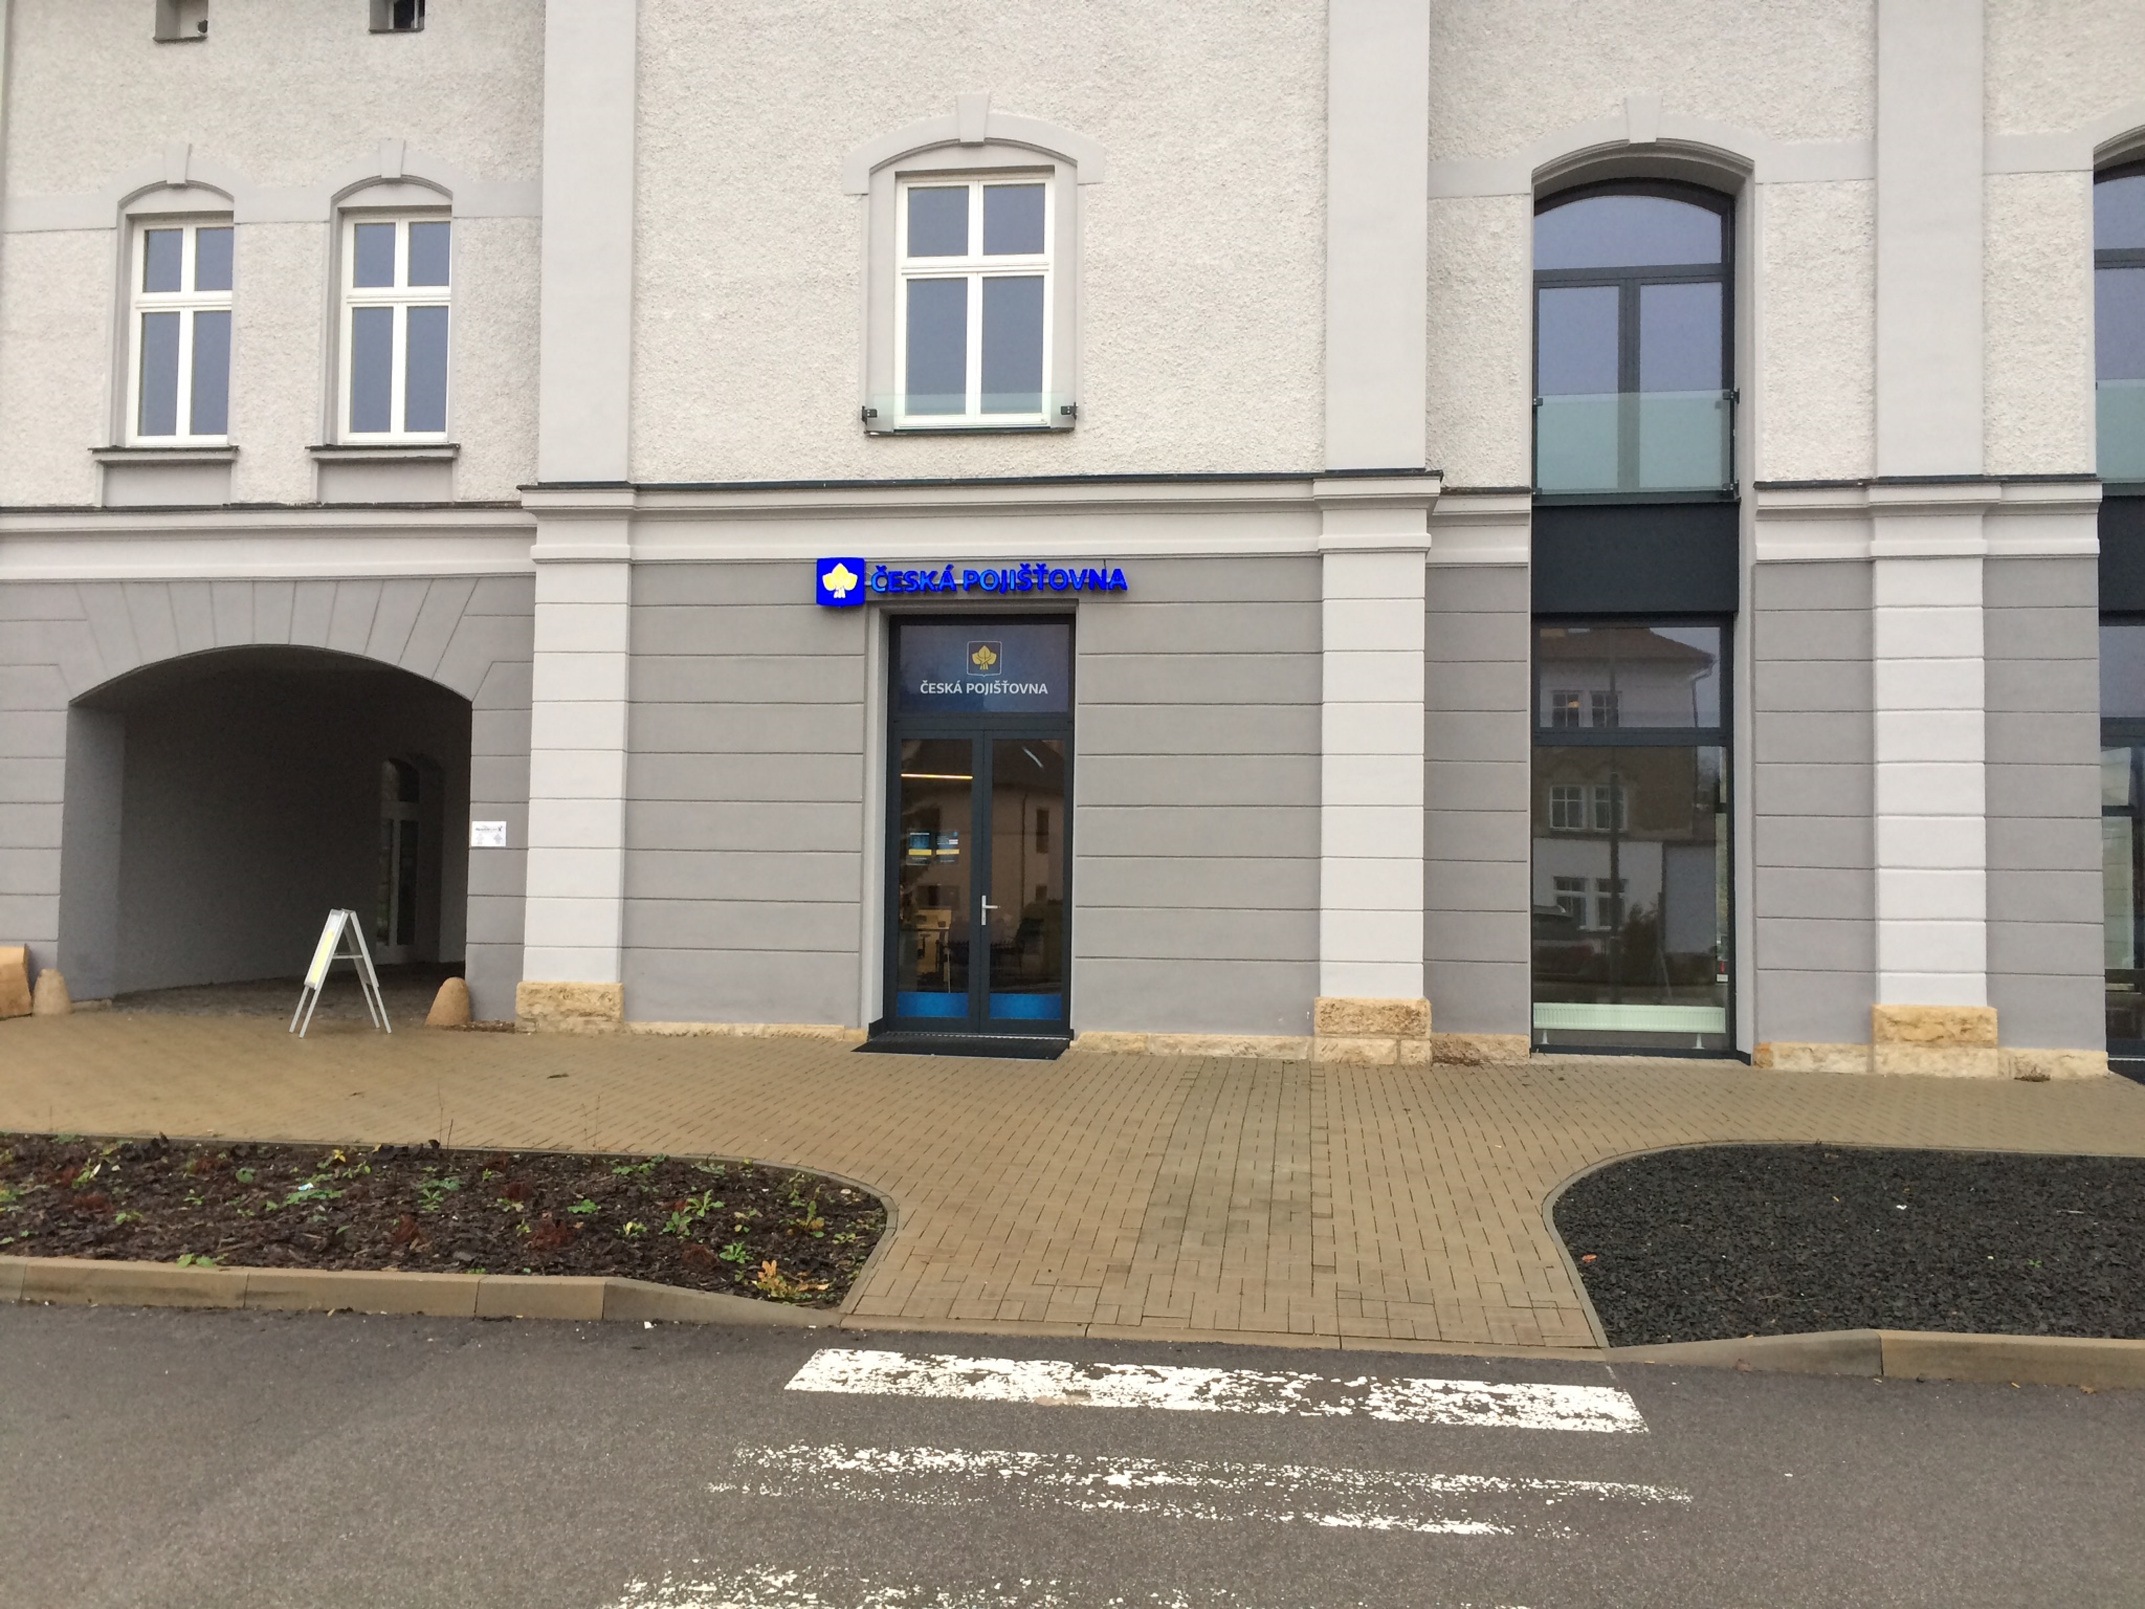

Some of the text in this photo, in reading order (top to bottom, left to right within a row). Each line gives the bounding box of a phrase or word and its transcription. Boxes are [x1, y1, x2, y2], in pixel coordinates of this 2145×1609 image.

[871, 563, 1128, 594] ČESKÁ POJIŠŤOVNA
[920, 680, 1049, 696] ČESKÁ POJIŠŤOVNA
